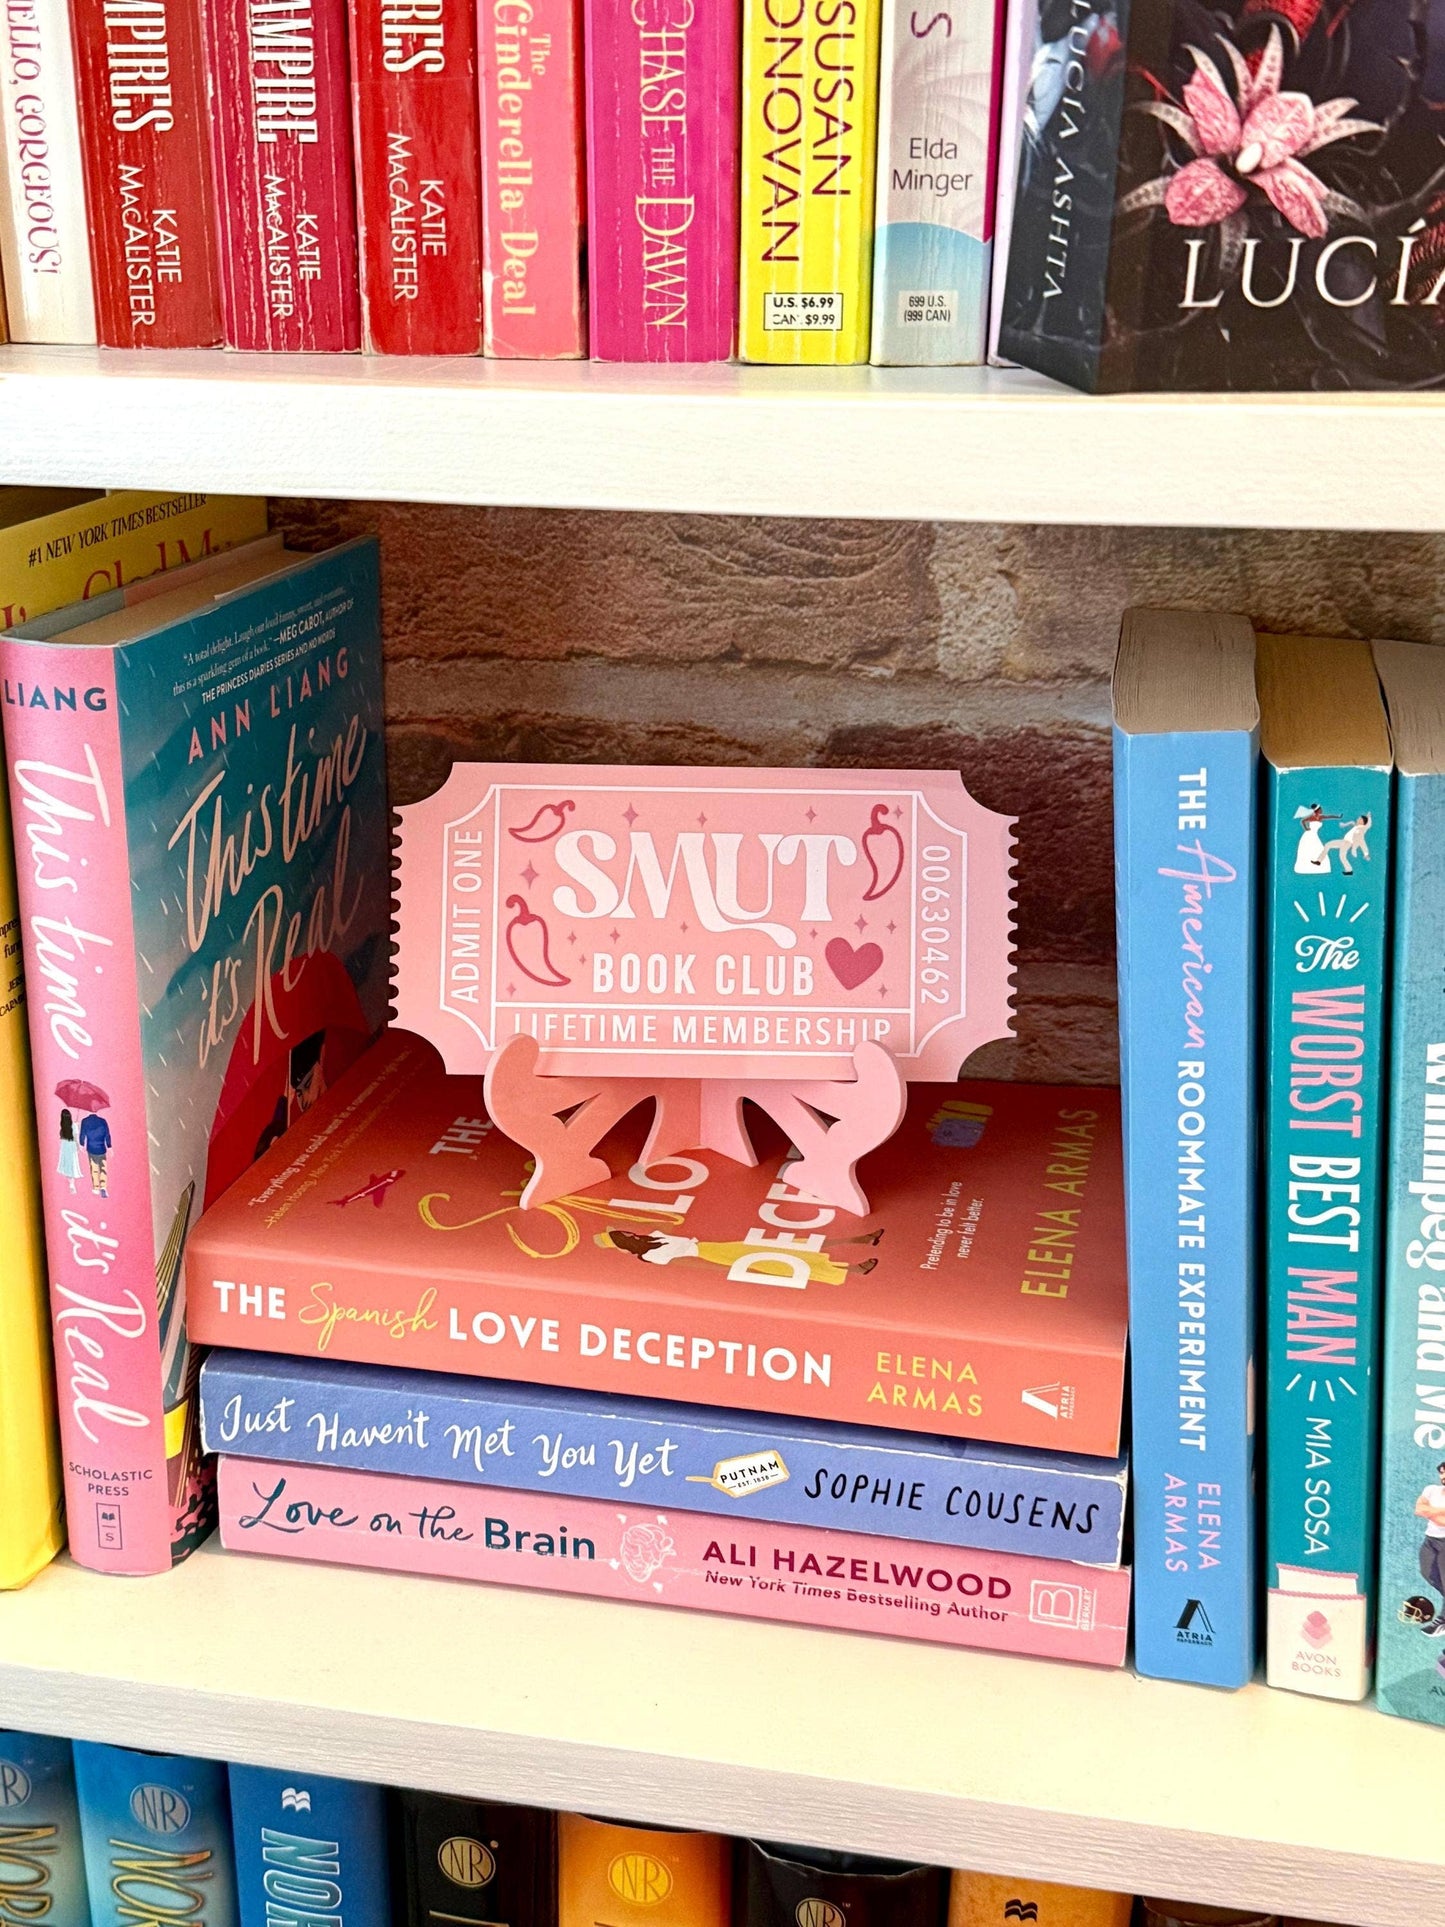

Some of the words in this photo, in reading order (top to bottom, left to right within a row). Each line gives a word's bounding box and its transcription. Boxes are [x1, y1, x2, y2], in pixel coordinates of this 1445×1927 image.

[529, 33, 552, 76] The
[631, 0, 695, 136] CHASE
[493, 0, 534, 212] Cinderella
[811, 1, 857, 196] SUSAN
[651, 143, 676, 188] THE
[910, 137, 957, 160] Elda
[15, 94, 63, 276] GORGEOUS!
[387, 132, 419, 302] MACALISTER
[892, 170, 973, 198] Minger
[118, 164, 156, 327] MACALISTER
[152, 209, 183, 284] KATIE
[264, 174, 293, 318] MACALISTER
[295, 213, 322, 281] KATIE
[419, 180, 447, 256] KATIE
[1042, 157, 1075, 299] ASHTA
[500, 230, 539, 316] Deal
[636, 195, 695, 328] DAWN
[773, 297, 798, 309] U.S.
[801, 297, 834, 309] $6.99
[805, 314, 835, 326] $9.99
[909, 296, 925, 308] 699
[927, 296, 947, 308] U.S.
[925, 310, 951, 323] CAN)
[29, 547, 42, 568] #1
[45, 533, 75, 562] NEW
[79, 522, 109, 549] YORK
[111, 513, 145, 537] TIMES
[145, 494, 207, 525] BESTSELLER
[173, 682, 186, 696] this
[198, 663, 227, 688] sparkling
[299, 611, 325, 634] CABOT,
[202, 689, 216, 705] THE
[216, 673, 249, 698] PRINCESS
[249, 659, 274, 681] DIARIES
[274, 649, 295, 667] SERIES
[2, 679, 107, 712] LIANG
[188, 699, 251, 766] ANN
[269, 647, 349, 719] LIANG
[14, 743, 111, 894] This
[167, 770, 273, 953] This
[281, 713, 368, 864] time
[1178, 768, 1207, 831] THE
[452, 830, 483, 893] ONE
[552, 829, 857, 949] SMUT
[199, 957, 242, 1069] it's
[242, 804, 365, 1066] Real
[450, 904, 481, 1004] ADMIT
[920, 845, 951, 1005] 00630462
[1158, 838, 1237, 1049] American
[1294, 935, 1360, 973] The
[30, 915, 114, 1060] time
[593, 953, 696, 995] BOOK
[715, 954, 815, 996] CLUB
[672, 1015, 891, 1046] MEMBERSHIP
[1290, 984, 1365, 1139] WORST
[1044, 1109, 1098, 1197] ARMAS
[1177, 1060, 1206, 1250] ROOMMATE
[935, 1207, 955, 1217] be
[935, 1218, 952, 1227] to
[941, 1181, 963, 1197] love
[960, 1198, 985, 1221] better.
[1288, 1153, 1361, 1252] BEST
[60, 1208, 119, 1278] it's
[919, 1229, 954, 1270] Pretending
[956, 1222, 978, 1235] felt
[957, 1236, 973, 1258] never
[1020, 1208, 1083, 1300] ELENA
[212, 1281, 286, 1319] THE
[298, 1282, 439, 1352] Spanish
[449, 1308, 560, 1353] LOVE
[580, 1324, 832, 1388] DECEPTION
[1286, 1266, 1359, 1366] MAN
[55, 1281, 151, 1447] Real
[875, 1351, 978, 1386] ELENA
[1178, 1262, 1207, 1453] EXPERIMENT
[866, 1381, 984, 1418] ARMAS
[1060, 1385, 1070, 1419] ATRIA
[68, 1461, 153, 1481] SCHOLASTIC
[220, 1394, 295, 1442] Just
[307, 1409, 430, 1453] Haven't
[444, 1420, 516, 1472] Met
[532, 1433, 596, 1477] You
[608, 1438, 679, 1488] Yet
[720, 1461, 779, 1484] PUTNAM
[1304, 1417, 1333, 1470] MIA
[87, 1483, 129, 1497] PRESS
[738, 1480, 753, 1488] EST.
[805, 1468, 926, 1510] SOPHIE
[945, 1486, 1100, 1535] COUSENS
[1303, 1477, 1331, 1556] SOSA
[239, 1478, 360, 1533] Love
[370, 1512, 403, 1535] on
[409, 1506, 474, 1542] the
[484, 1518, 596, 1560] Brain
[1164, 1472, 1188, 1573] ARMAS
[1198, 1483, 1221, 1570] ELENA
[702, 1541, 757, 1567] ALI
[773, 1548, 1012, 1600] HAZELWOOD
[705, 1570, 743, 1587] New
[749, 1574, 787, 1594] York
[791, 1581, 842, 1600] Times
[846, 1588, 942, 1617] Bestselling
[947, 1601, 1009, 1623] Author
[1177, 1631, 1213, 1642] ATRIA
[1291, 1661, 1341, 1678] BOOKS
[1296, 1651, 1337, 1665] AVON
[140, 1787, 180, 1832] NR
[449, 1840, 488, 1882] NR
[620, 1853, 664, 1901] NR
